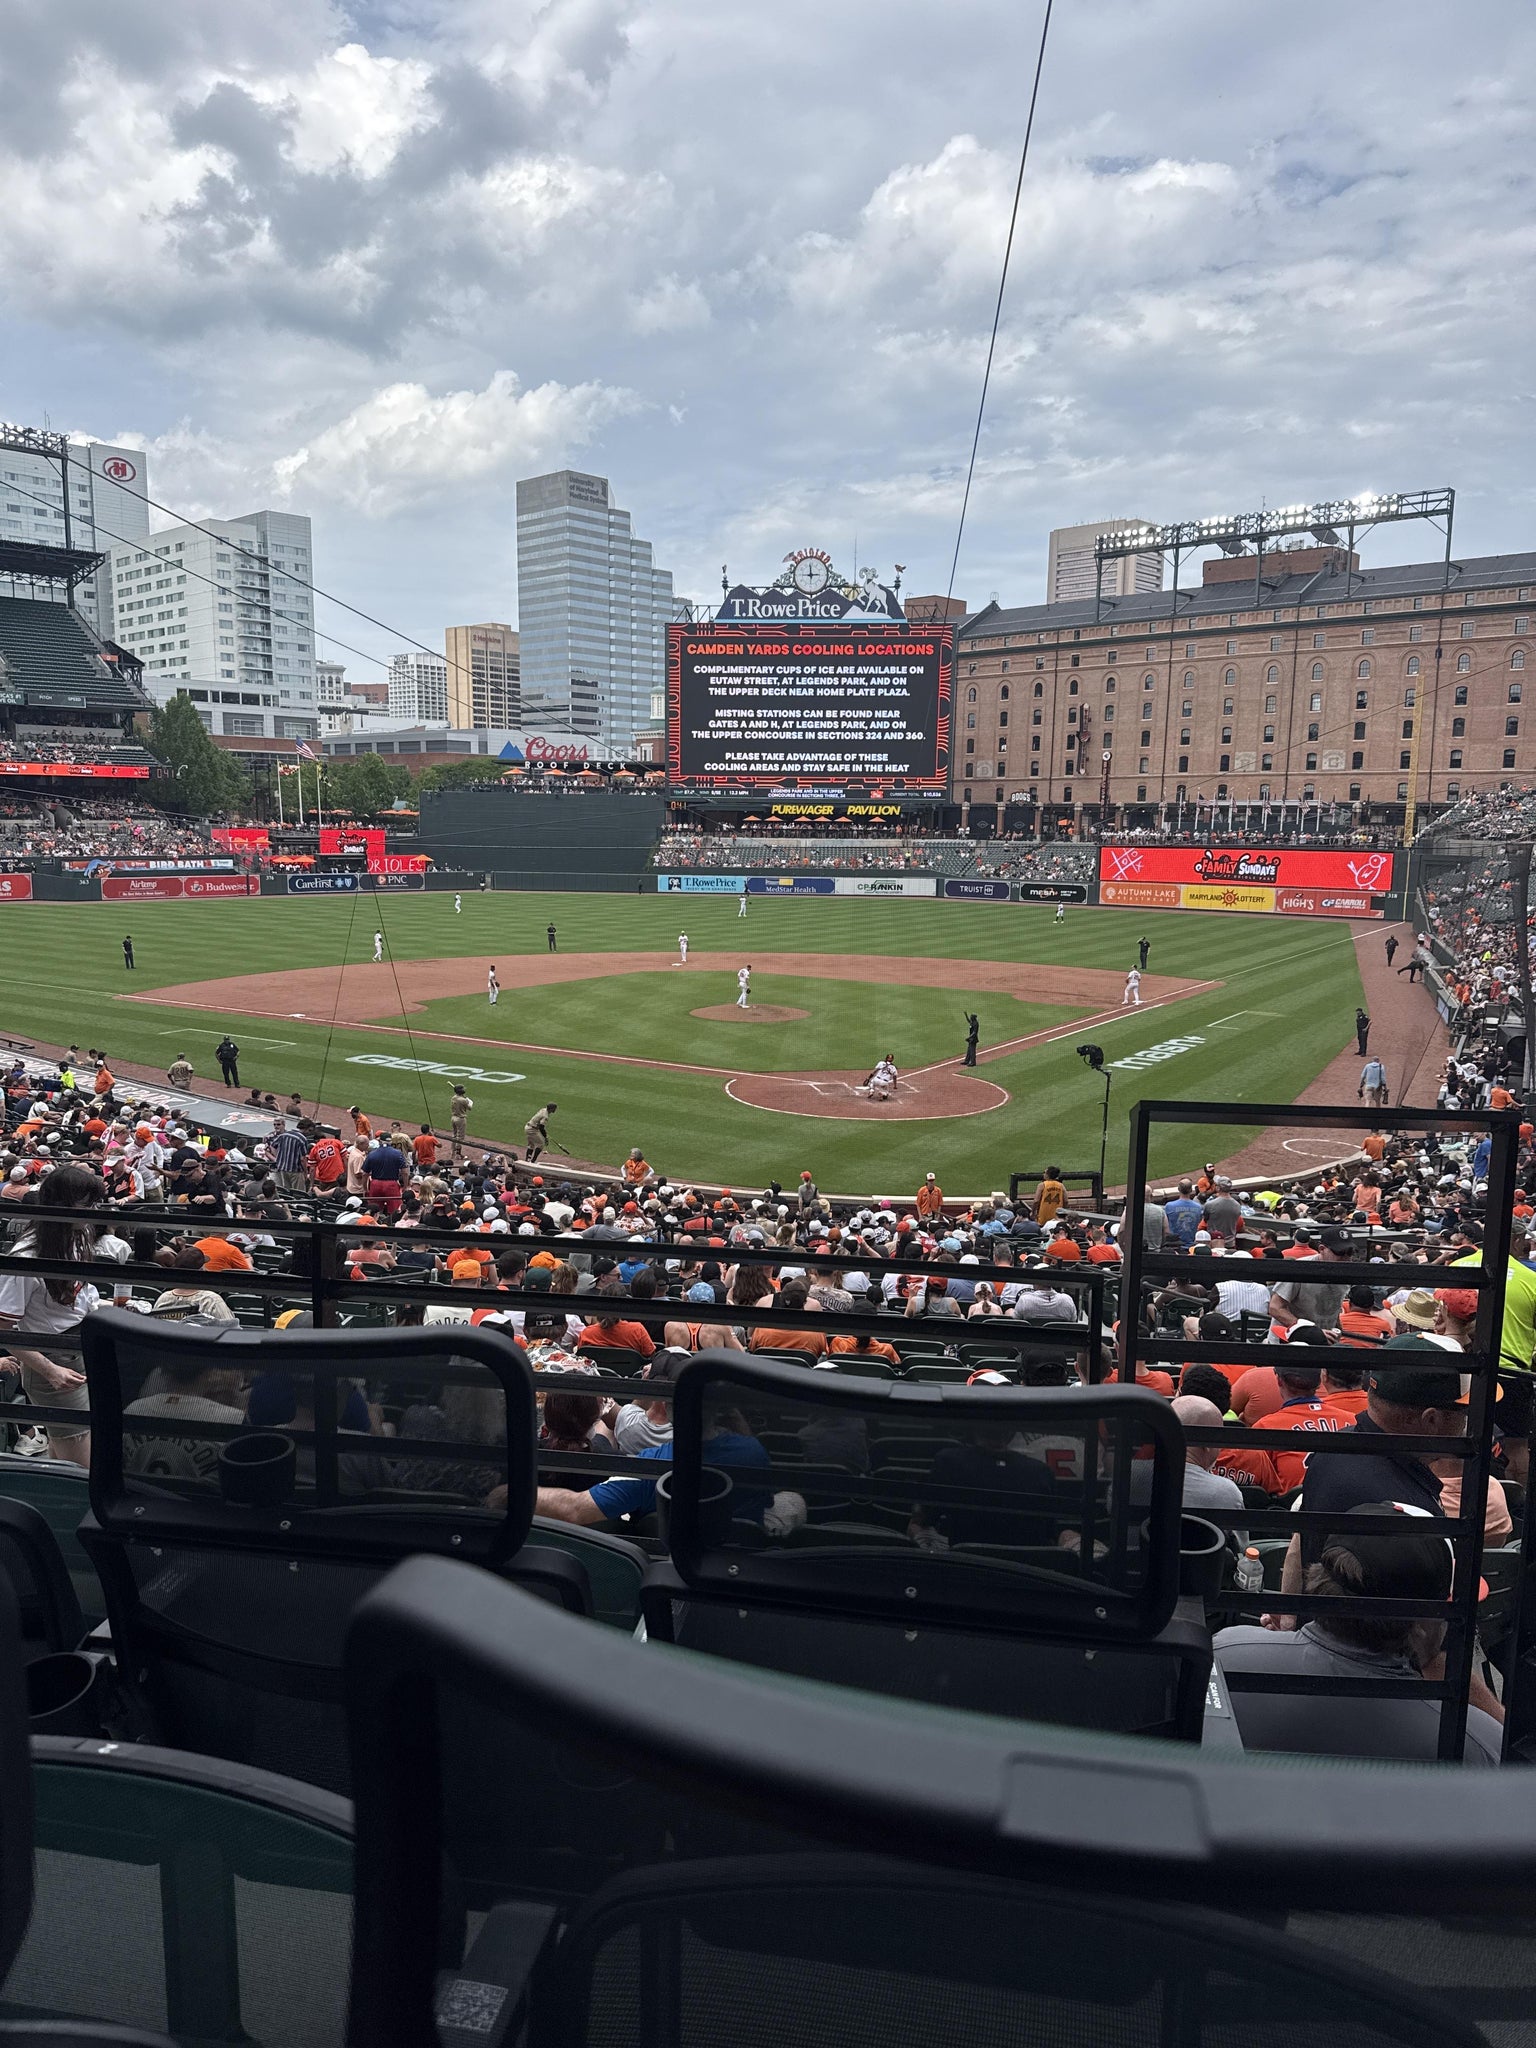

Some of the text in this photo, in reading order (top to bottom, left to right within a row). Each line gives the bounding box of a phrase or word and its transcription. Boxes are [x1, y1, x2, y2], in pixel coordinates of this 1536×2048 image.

[569, 476, 594, 488] University
[575, 485, 599, 496] Maryland
[569, 491, 608, 505] Medical System
[798, 598, 841, 617] Price
[686, 643, 934, 656] CAMDEN YARDS COOLING LOCATIONS
[693, 665, 924, 675] COMPLIMENTARY CUPS OF ICE ARE AVAILABLE ON
[709, 676, 907, 686] EUTAW STREET, AT LEGENDS PARK, AND ON
[708, 687, 911, 697] THE UPPER DECK NEAR HOME PLATE PLAZA.
[715, 709, 901, 718] MISTING STATIONS CAN BE FOUND NEAR
[708, 720, 907, 729] GATES A AND H, AT LEGENDS PARK, AND ON
[691, 730, 927, 740] THE UPPER CONCOURSE IN SECTIONS 324 AND 360.
[525, 736, 589, 761] Coors
[725, 752, 889, 762] PLEASE TAKE ADVANTAGE OF THESE
[524, 760, 626, 770] ROOF DECK
[703, 762, 910, 773] COOLING AREAS AND STAY SAFE IN THE HEAT
[771, 804, 901, 816] PUREWAGER PAVILION
[149, 860, 175, 869] BIRD
[177, 860, 204, 869] BATH
[368, 858, 423, 873] ORIOLES
[1201, 859, 1277, 877] FAMILY SUNDAYS
[131, 880, 158, 889] Airtemp
[295, 878, 335, 889] CareFirst
[387, 875, 408, 884] PNC
[715, 877, 737, 887] Price
[959, 885, 983, 893] TRUIST
[1117, 888, 1176, 898] AUTUMN LAKE
[1189, 893, 1223, 901] MARYLAND
[1282, 897, 1314, 911] HIGH'S
[1334, 898, 1367, 907] CARROLL
[344, 1054, 527, 1084] GEICO
[318, 1145, 335, 1160] 22
[1044, 1192, 1060, 1205] 44
[434, 1315, 469, 1327] NDER
